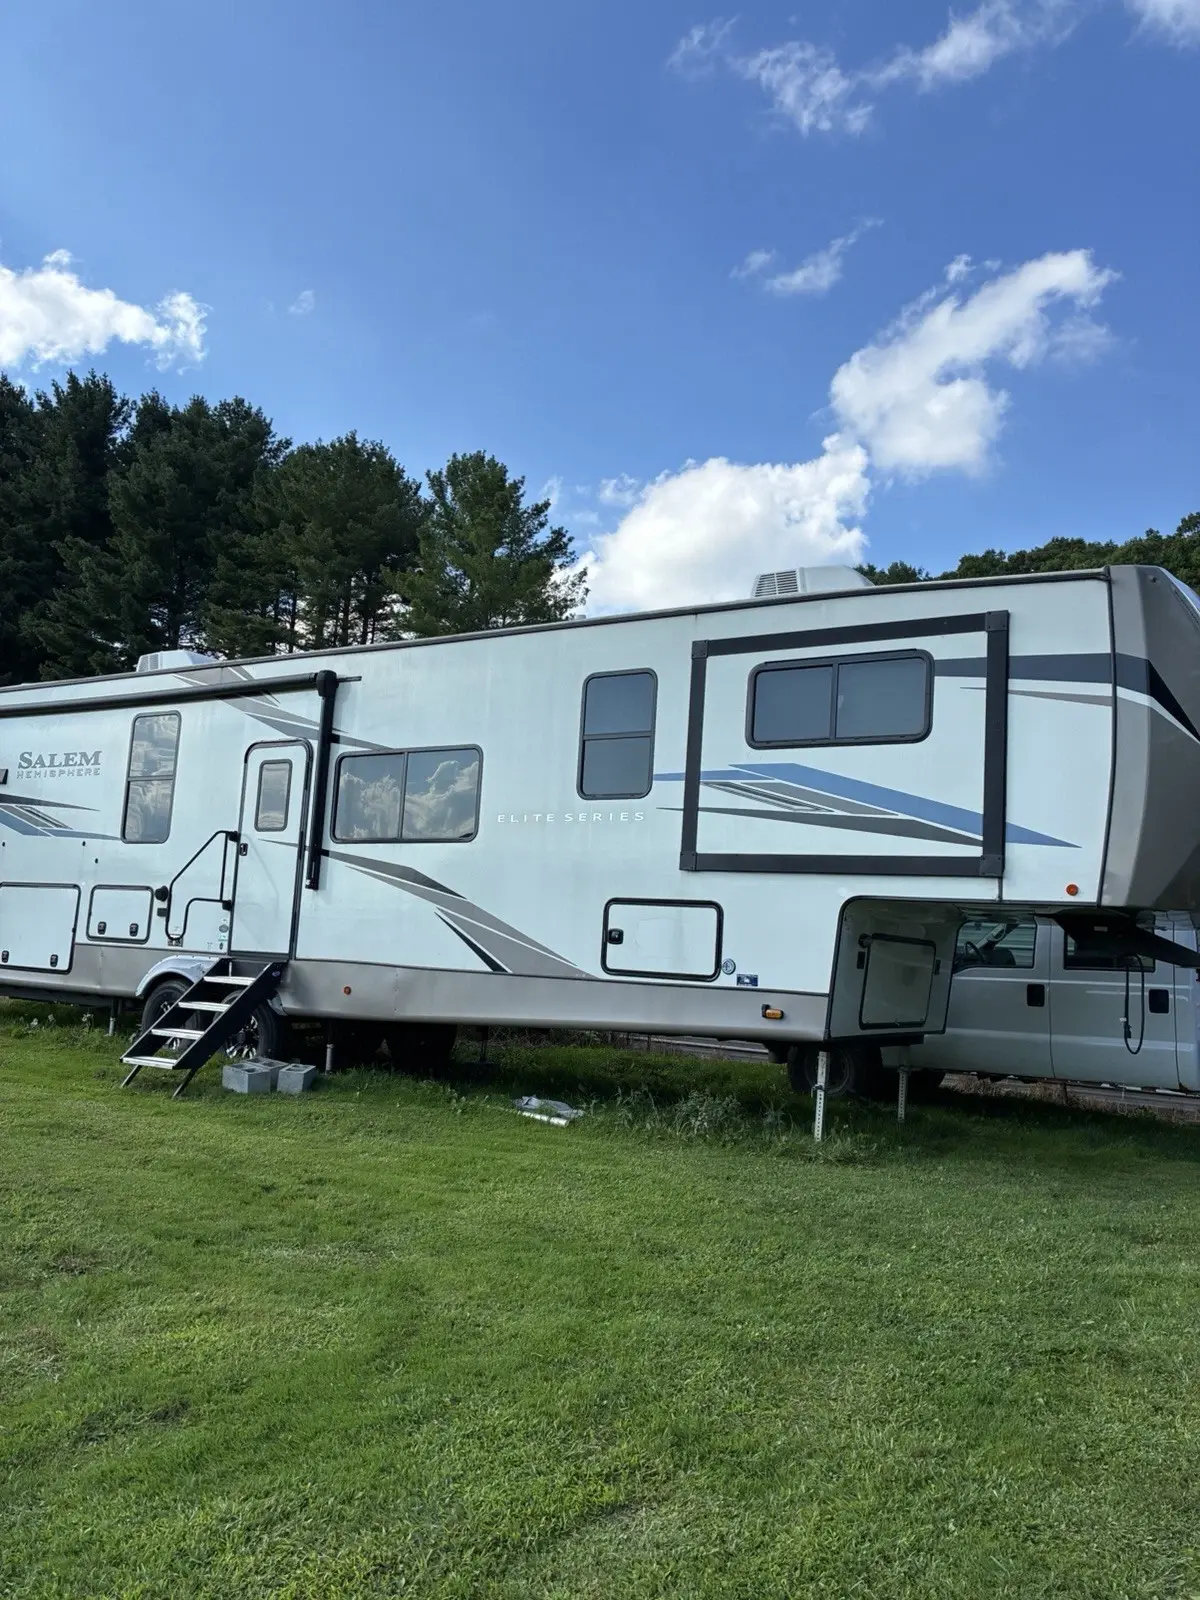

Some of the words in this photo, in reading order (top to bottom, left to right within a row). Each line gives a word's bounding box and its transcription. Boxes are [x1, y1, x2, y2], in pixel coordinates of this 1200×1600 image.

[18, 750, 102, 769] SALEM
[16, 767, 101, 779] HEMISPHERE
[497, 813, 555, 823] ELITE
[564, 811, 645, 822] SERIES
